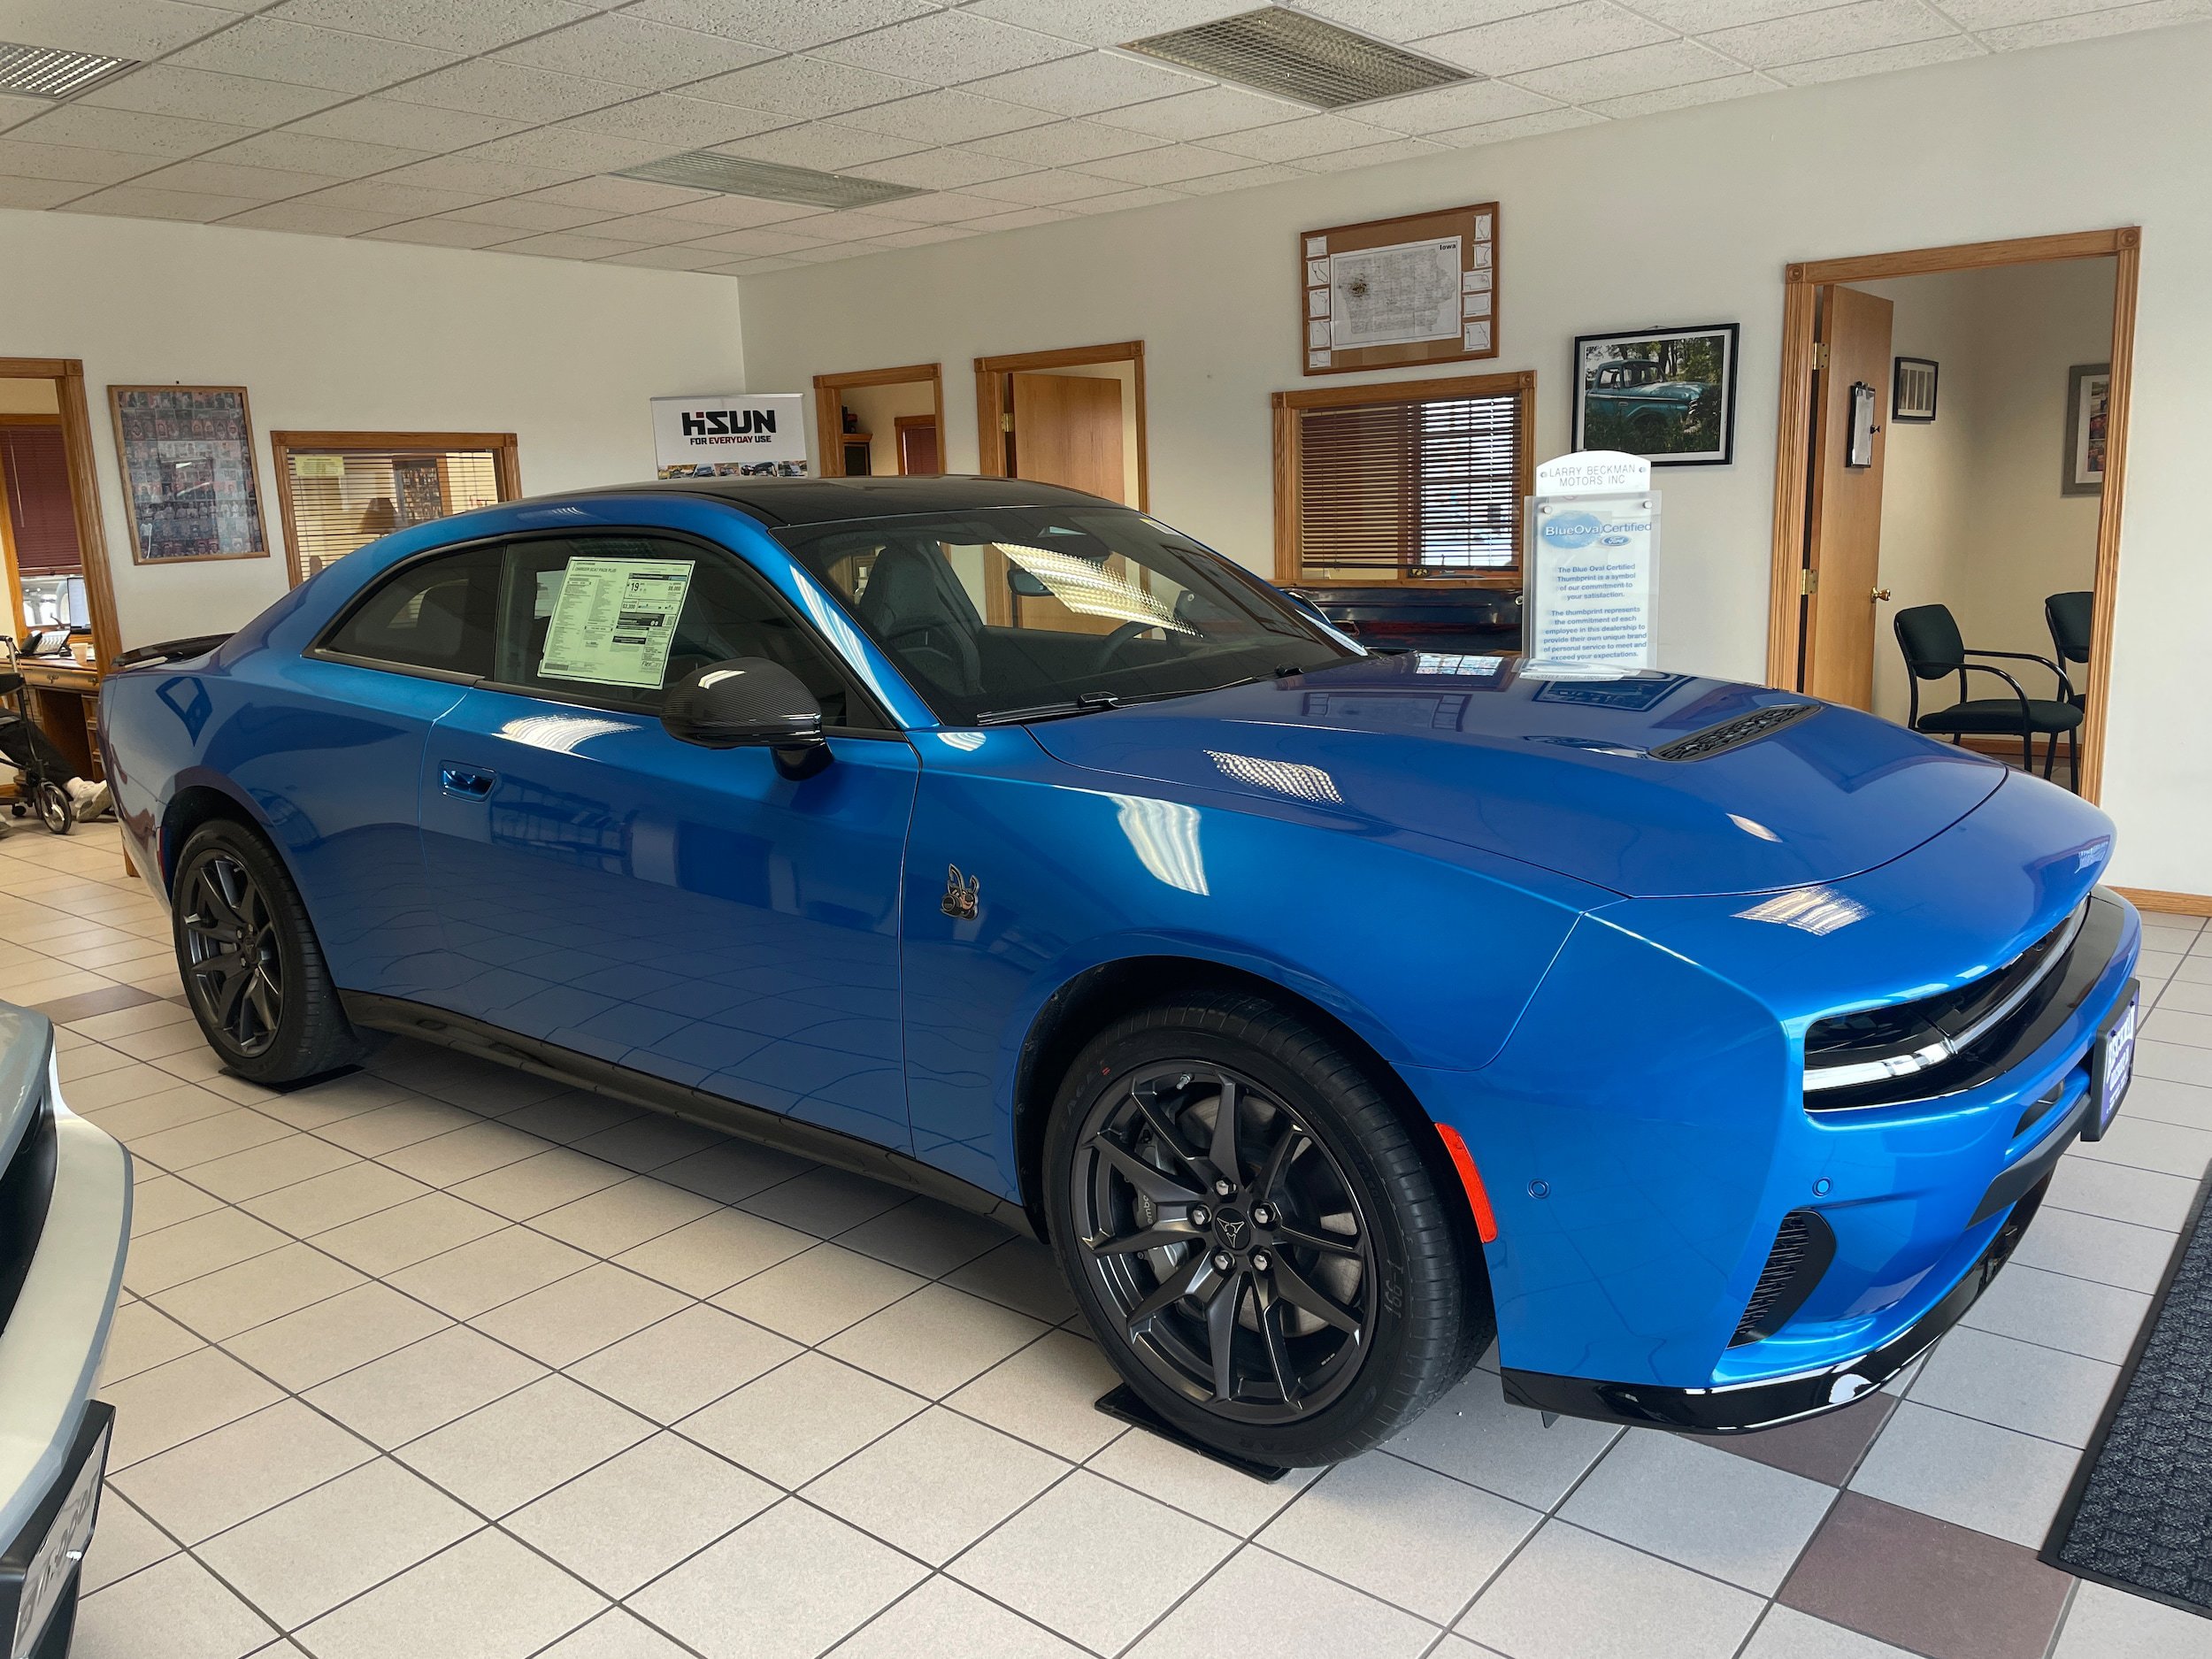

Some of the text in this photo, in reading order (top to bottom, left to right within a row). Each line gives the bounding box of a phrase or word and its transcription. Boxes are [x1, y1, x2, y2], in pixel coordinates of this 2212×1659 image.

[709, 435, 753, 444] EVERYDAY
[1549, 465, 1635, 478] LARRY BECKMAN
[1559, 474, 1625, 487] MOTORS INC
[1611, 572, 1635, 581] symbol
[1565, 608, 1603, 617] thumbprint
[1594, 651, 1639, 660] expectations.
